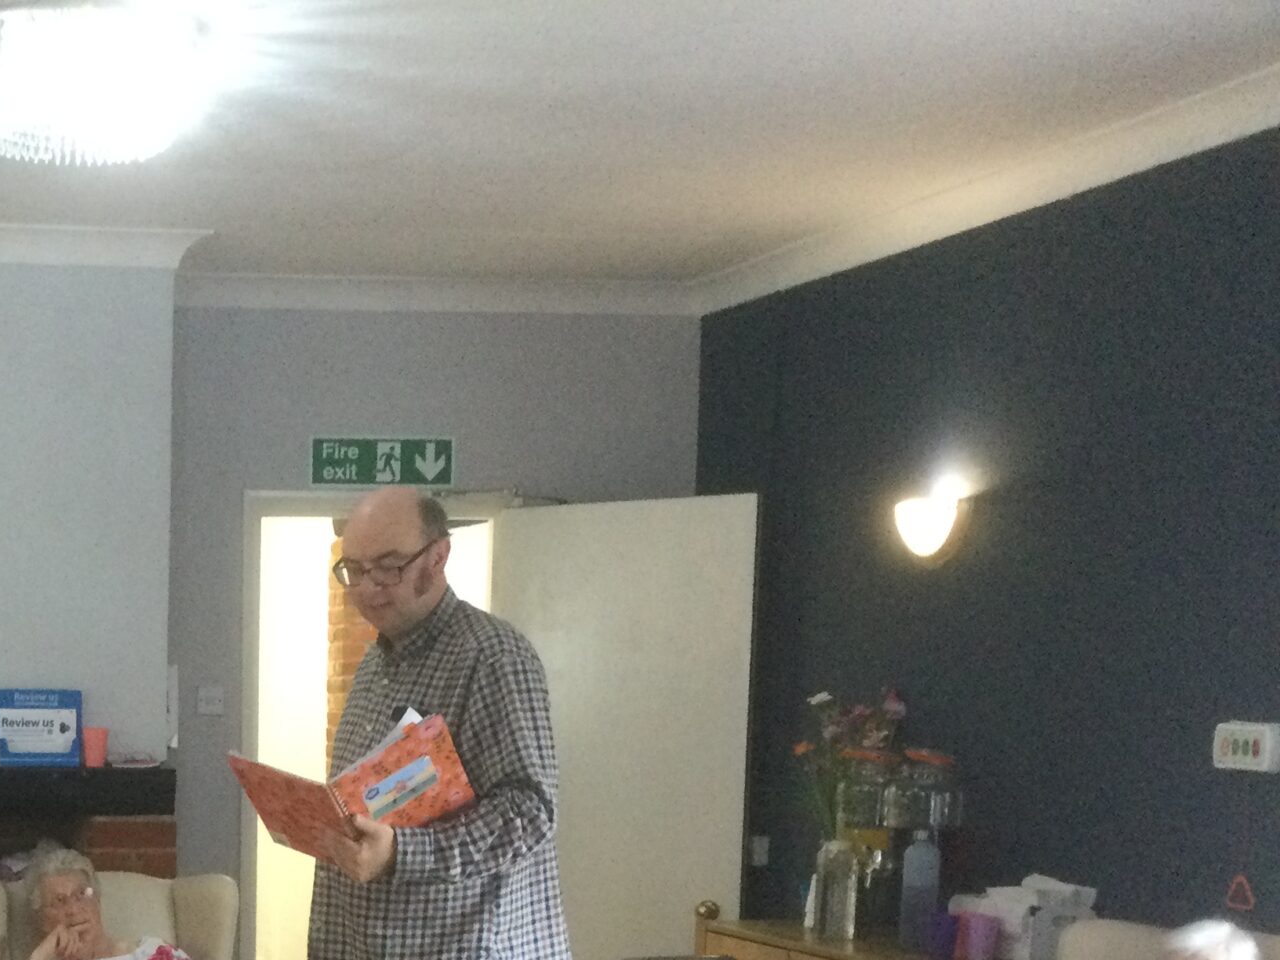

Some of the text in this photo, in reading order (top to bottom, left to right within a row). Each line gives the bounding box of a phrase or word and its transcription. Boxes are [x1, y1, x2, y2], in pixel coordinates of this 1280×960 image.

[323, 442, 359, 459] Fire
[323, 463, 358, 480] exit
[1, 717, 54, 727] Review us
